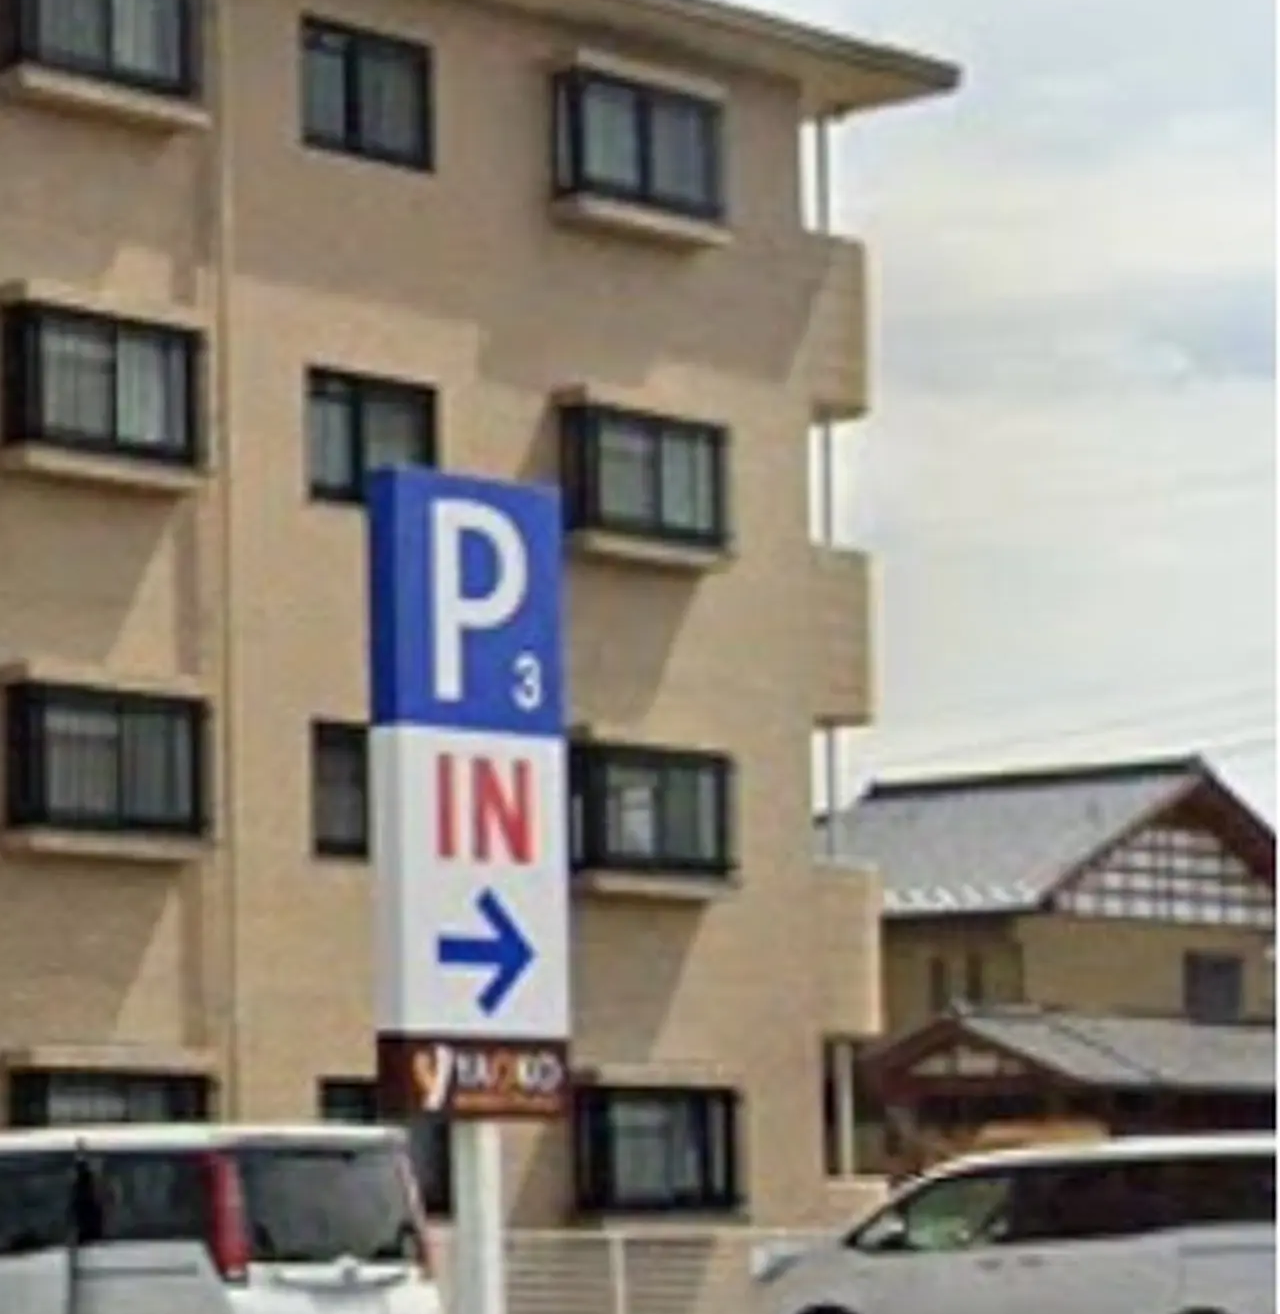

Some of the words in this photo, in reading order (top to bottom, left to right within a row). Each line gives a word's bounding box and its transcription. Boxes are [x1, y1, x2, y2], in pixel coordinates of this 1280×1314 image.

[430, 497, 529, 703] P
[512, 652, 544, 712] 3
[435, 753, 536, 865] IN
